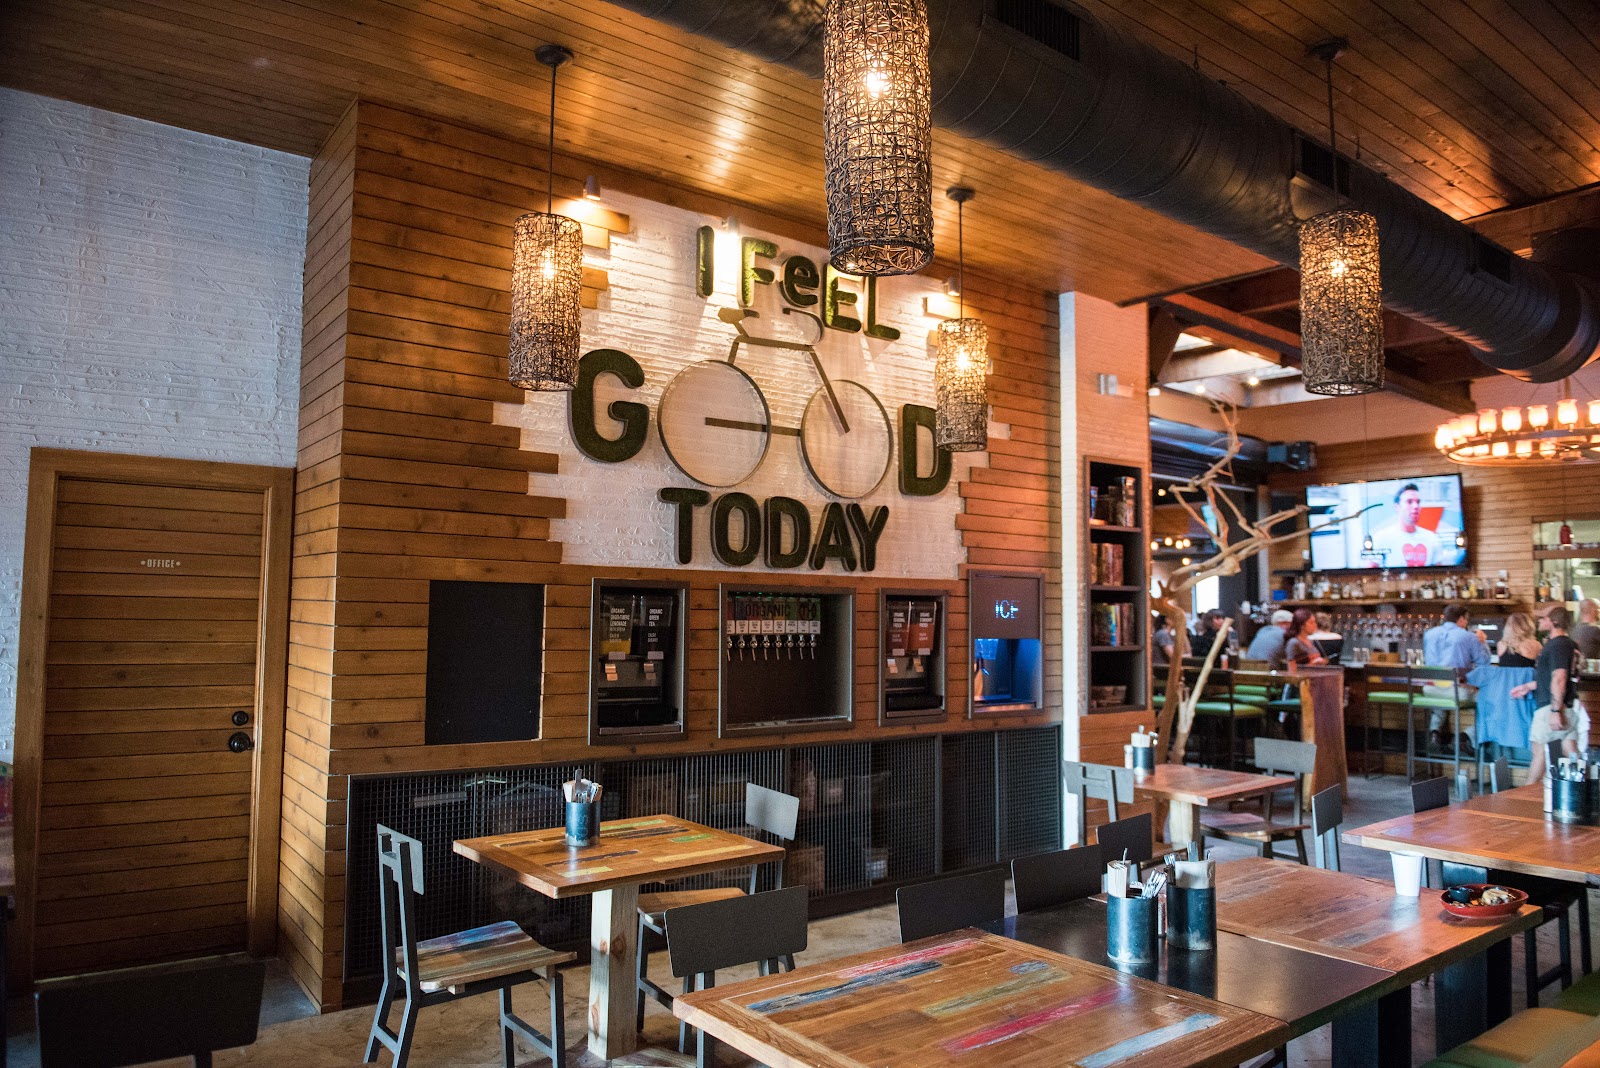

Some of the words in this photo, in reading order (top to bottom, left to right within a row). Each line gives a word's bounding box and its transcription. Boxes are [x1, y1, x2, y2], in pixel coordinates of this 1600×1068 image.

[696, 224, 715, 298] I
[656, 486, 890, 572] TODAY
[146, 558, 175, 568] OFFICE
[994, 599, 1021, 619] ICE
